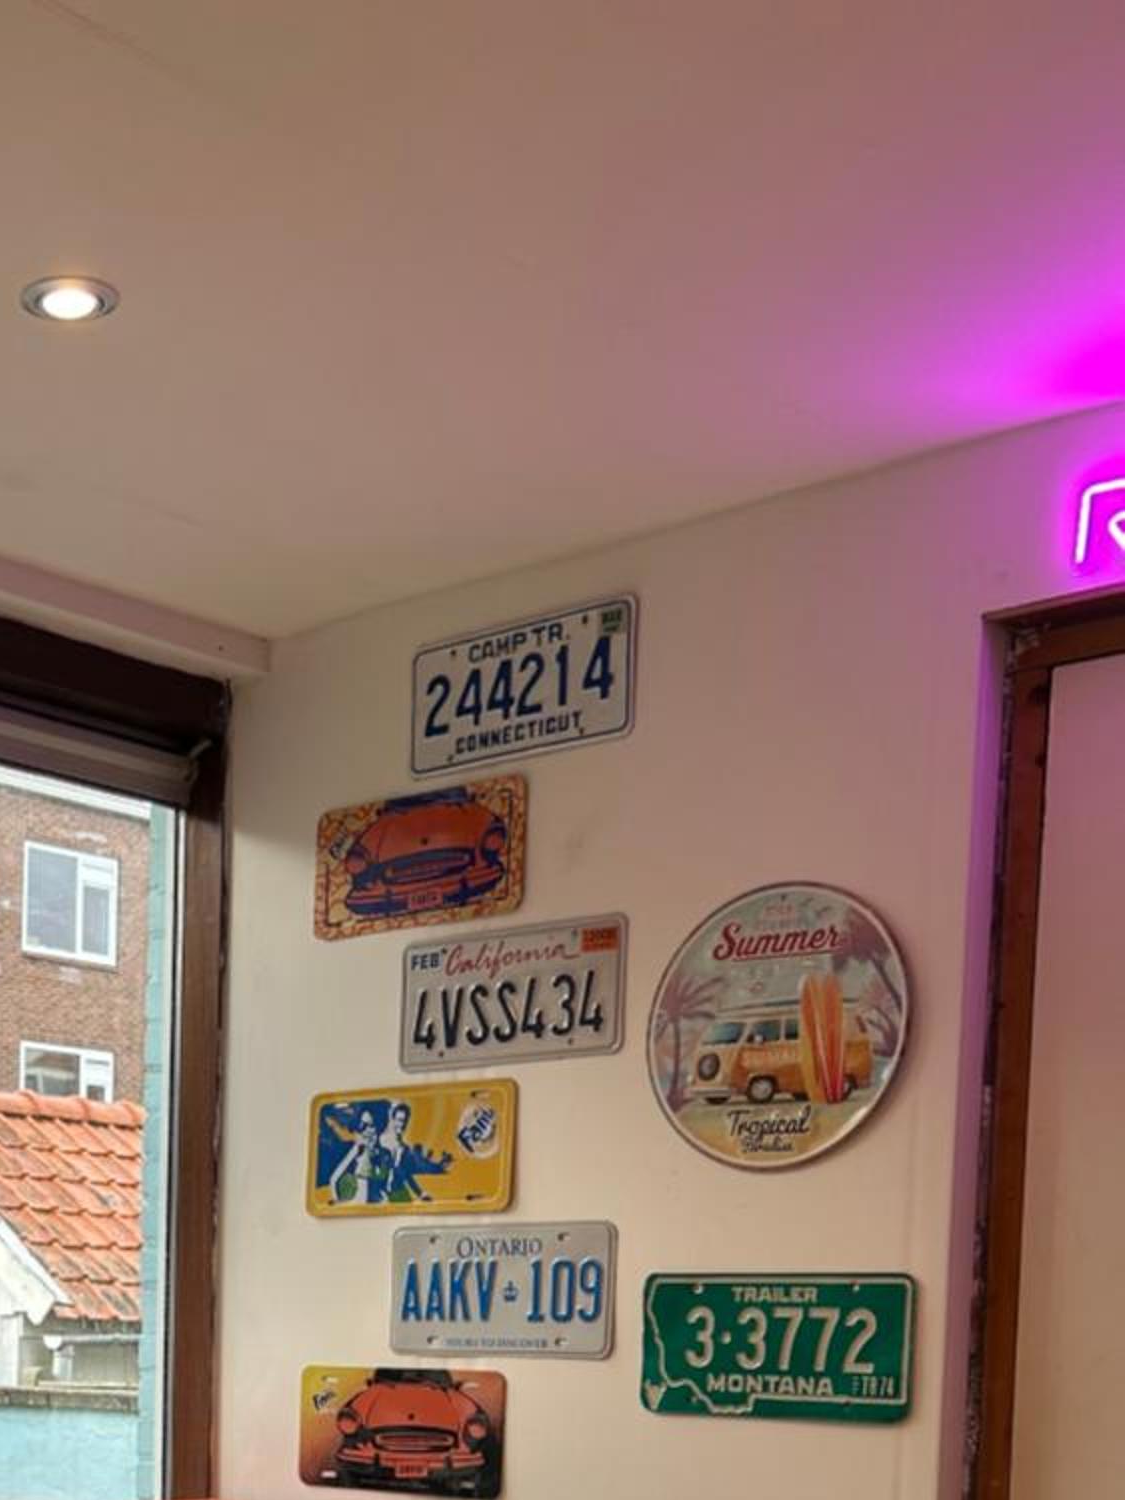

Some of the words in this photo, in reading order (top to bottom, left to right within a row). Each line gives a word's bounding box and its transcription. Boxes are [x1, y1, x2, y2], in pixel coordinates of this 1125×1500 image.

[468, 632, 528, 663] CAMP
[425, 635, 614, 738] 244214
[455, 710, 582, 754] CONNECTICUT
[411, 951, 441, 971] FEB
[445, 940, 580, 979] California
[713, 920, 839, 961] Summer
[413, 969, 604, 1050] 4VSS434
[727, 1104, 811, 1142] Tropical
[401, 1258, 498, 1322] AAKV
[527, 1258, 603, 1322] 109
[732, 1286, 819, 1304] TRAILER
[706, 1373, 834, 1397] MONTANA
